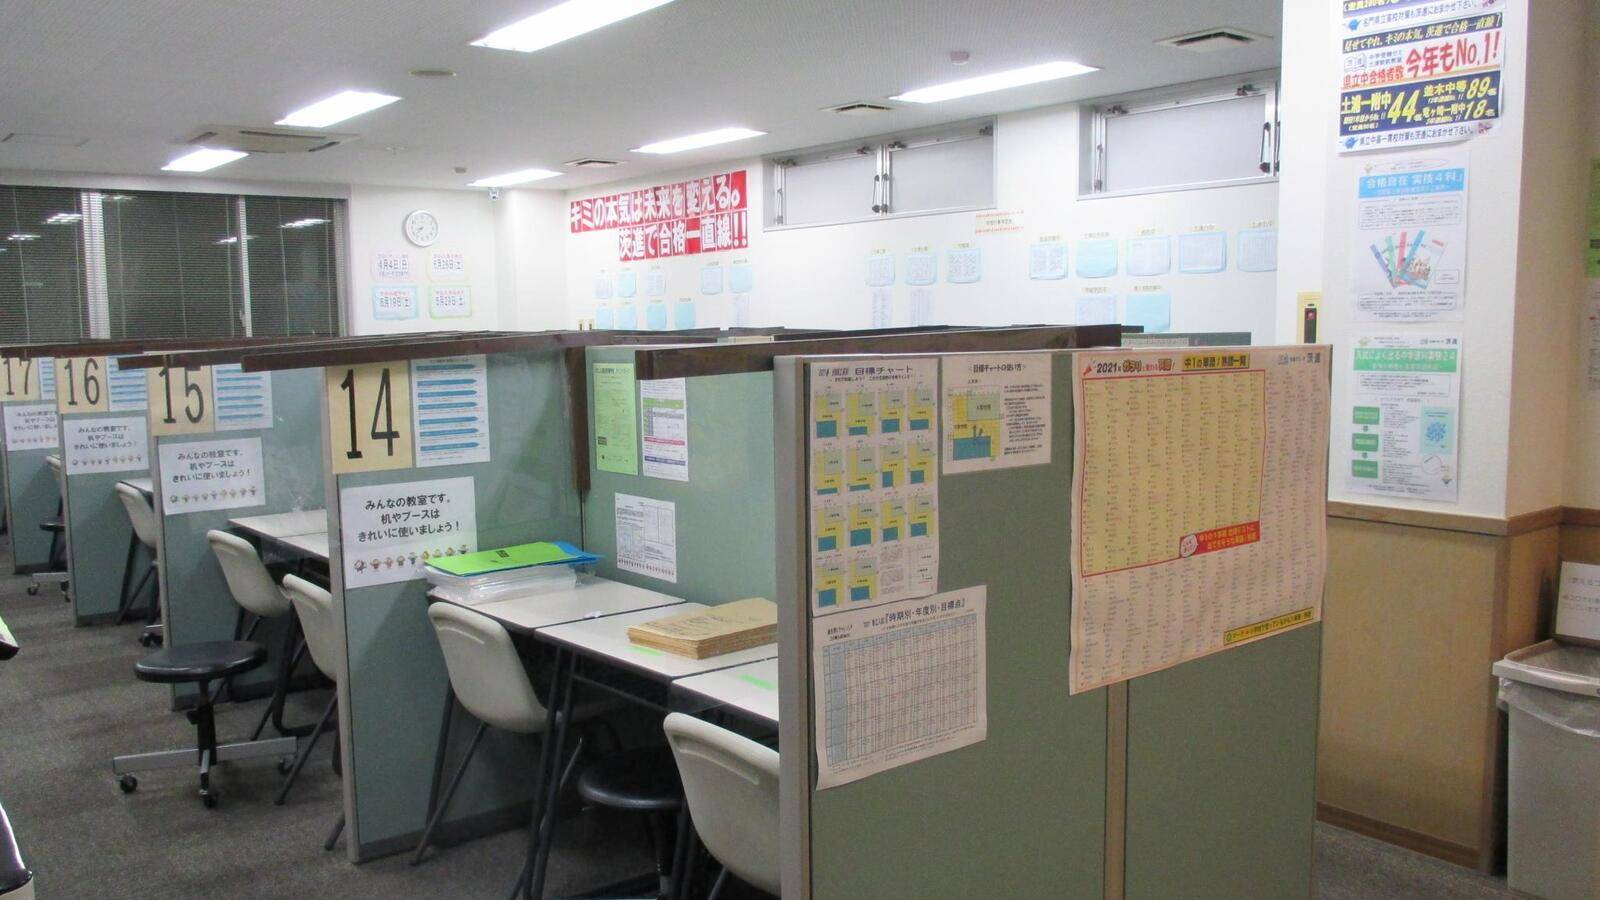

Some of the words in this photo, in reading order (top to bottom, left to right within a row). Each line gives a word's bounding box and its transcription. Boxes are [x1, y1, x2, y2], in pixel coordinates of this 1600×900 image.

[571, 175, 740, 230] キミの本気は未来を変える。
[619, 212, 747, 258] 茨進で合格一直線!!
[3, 358, 31, 395] 17
[64, 358, 100, 405] 16
[855, 364, 914, 376] 目標チャート
[159, 367, 204, 424] 15
[341, 368, 400, 459] 14
[177, 450, 243, 461] みんなの教室です。
[189, 460, 235, 471] 机やブースは
[365, 493, 451, 510] みんなの教室です。
[358, 520, 460, 542] きれいに使いましょう!
[380, 509, 440, 525] 机やブースは
